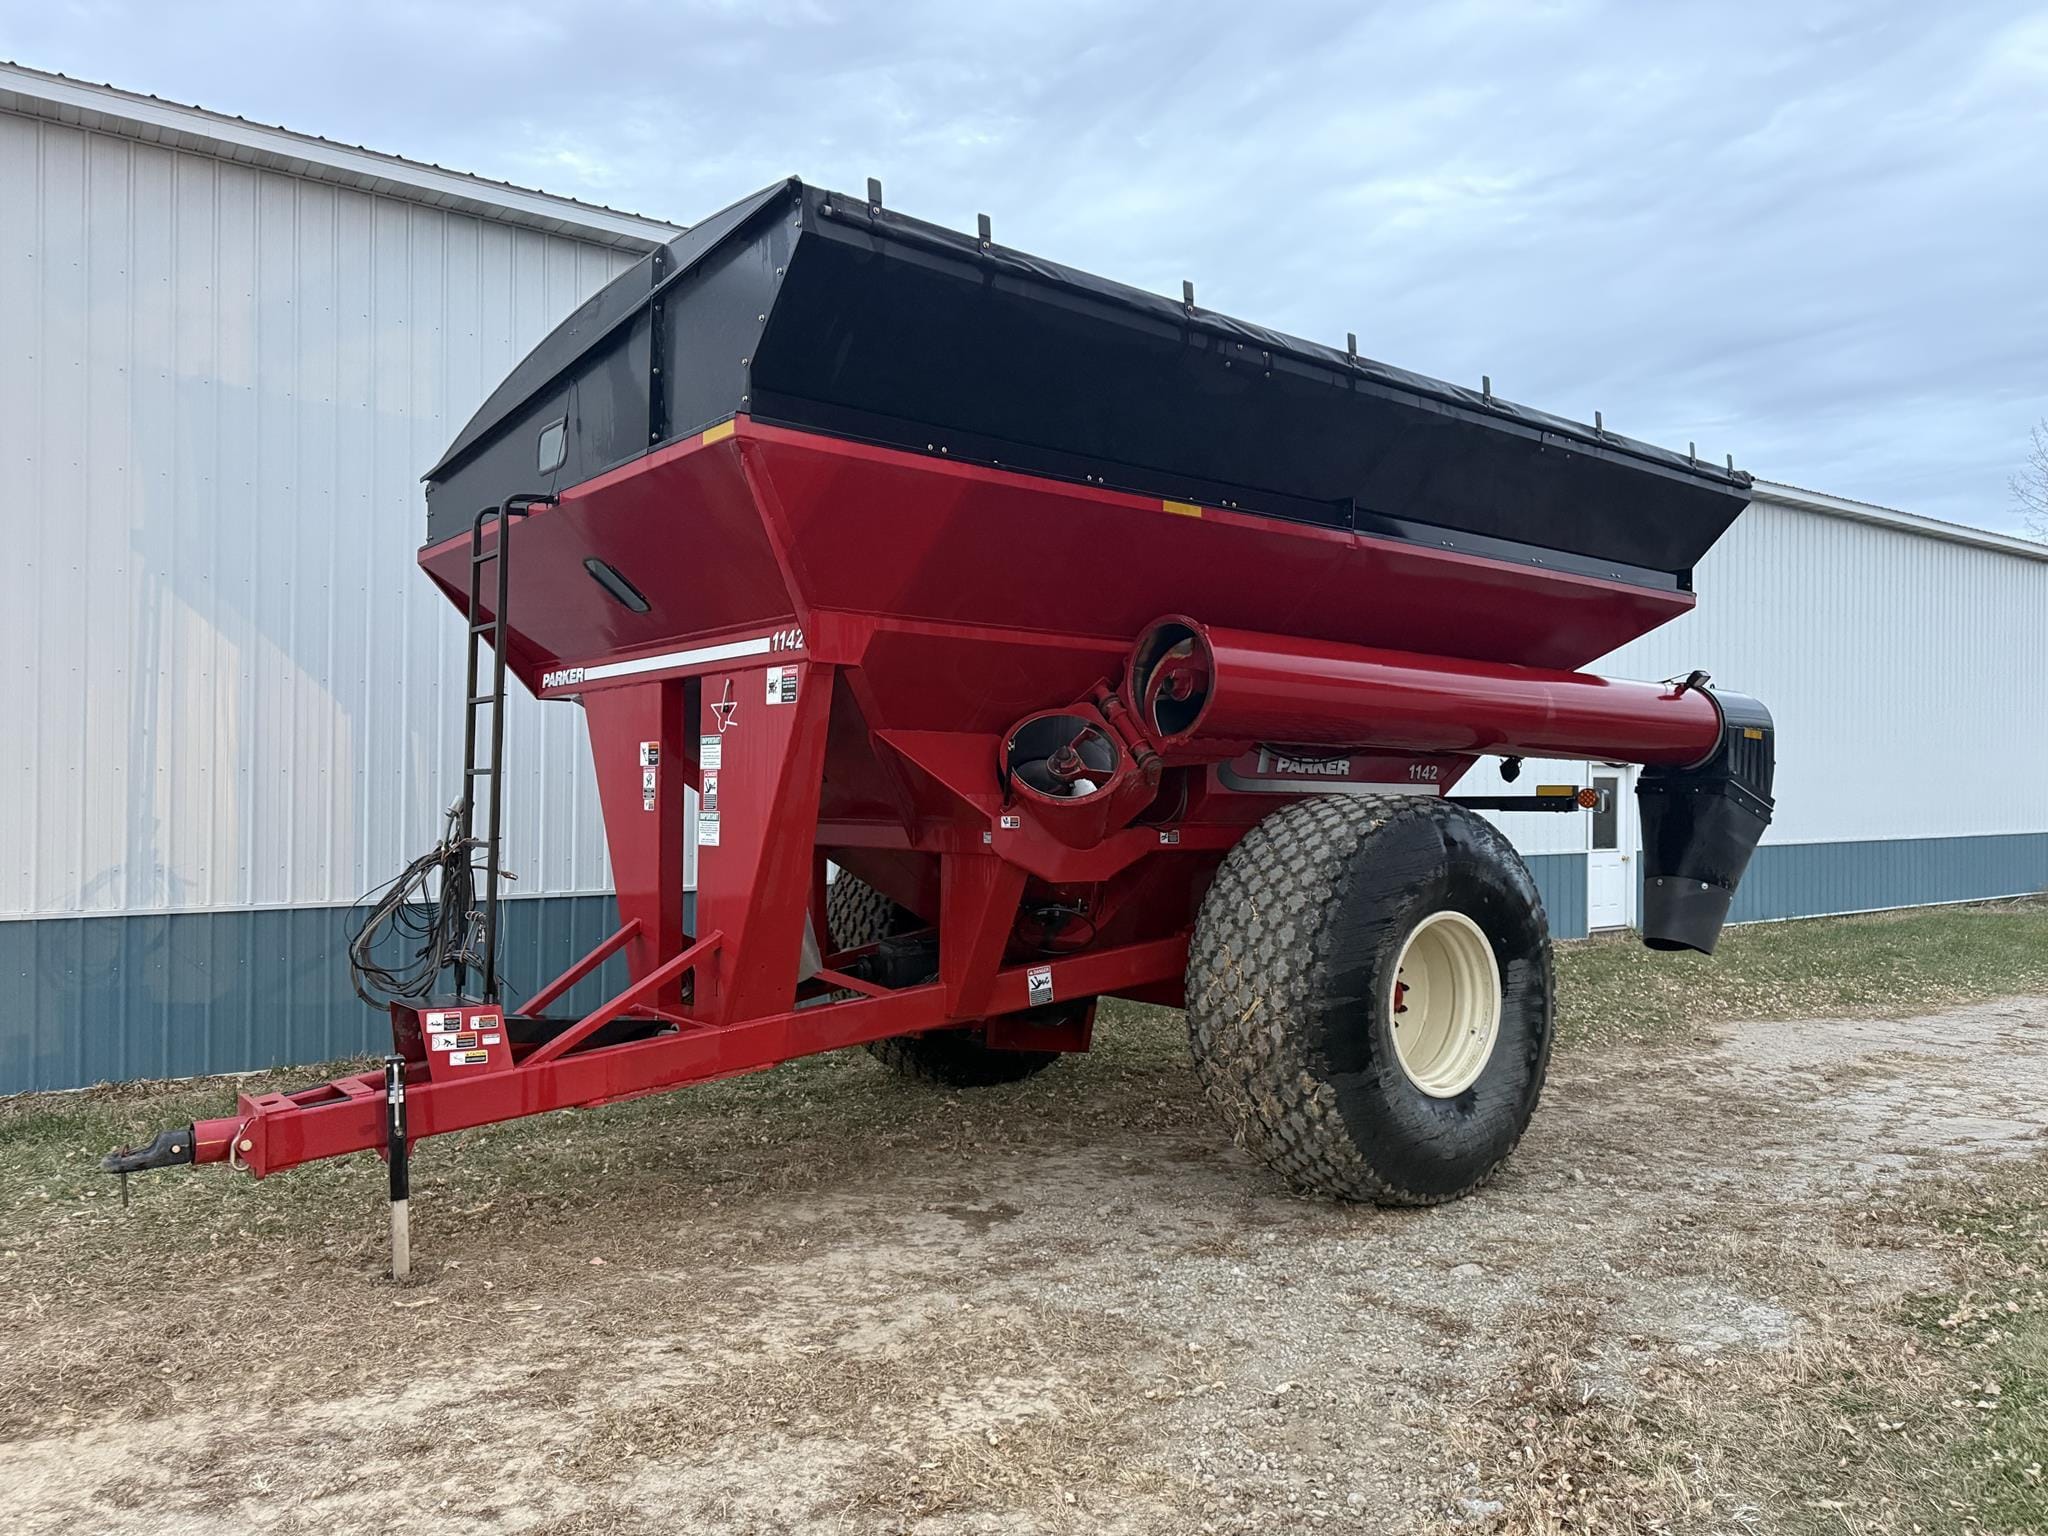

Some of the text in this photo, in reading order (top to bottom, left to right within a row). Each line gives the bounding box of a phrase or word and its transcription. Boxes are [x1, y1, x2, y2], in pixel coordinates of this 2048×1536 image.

[773, 629, 804, 652] 1142
[542, 667, 584, 688] PARKER
[1277, 757, 1350, 775] PARKER
[1409, 765, 1438, 780] 1142
